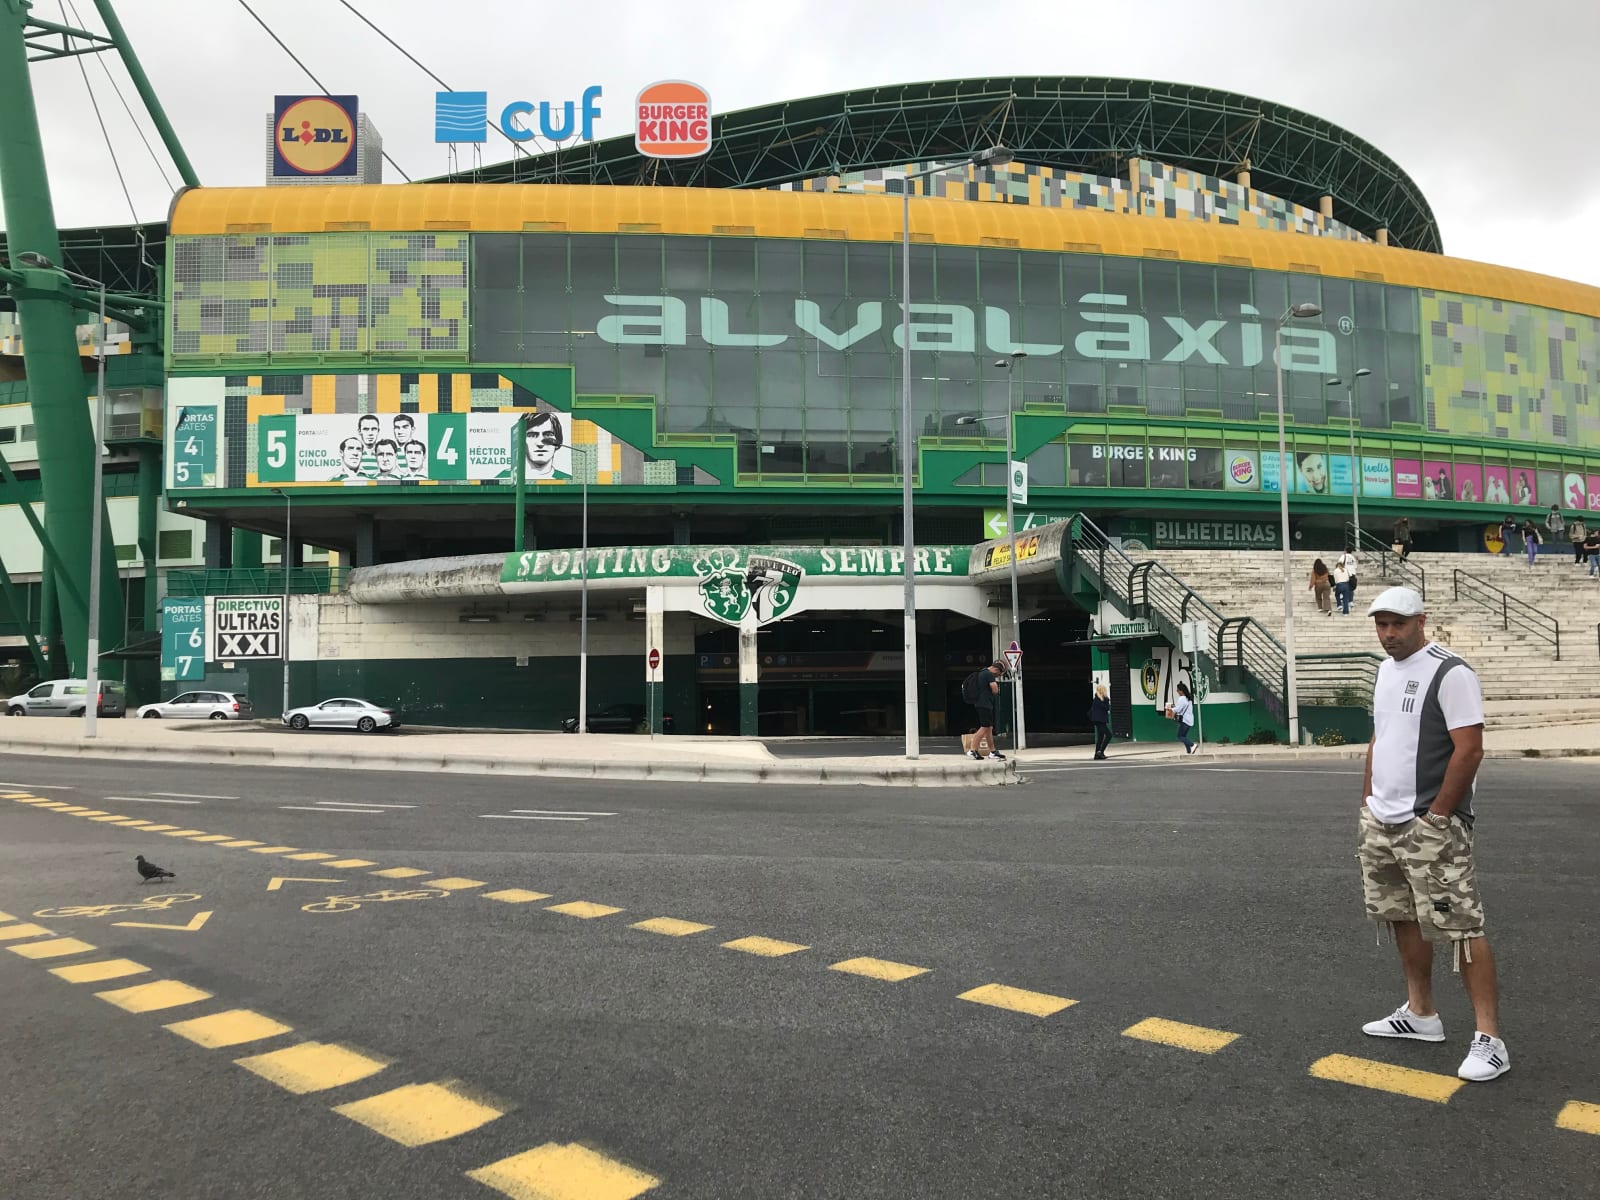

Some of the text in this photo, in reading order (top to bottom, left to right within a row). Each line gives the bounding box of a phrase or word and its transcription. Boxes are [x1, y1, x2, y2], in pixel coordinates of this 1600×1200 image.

[500, 85, 602, 142] cuf
[639, 105, 707, 120] BURGER
[639, 121, 708, 142] KING
[184, 436, 199, 455] 4
[266, 430, 287, 468] 5
[299, 450, 327, 458] CINCO
[436, 428, 458, 465] 4
[469, 445, 506, 456] HÉCTOR
[1092, 446, 1197, 462] BURGER KING
[299, 459, 342, 467] VIOLINOS
[469, 457, 512, 465] YAZALDE
[1363, 463, 1390, 473] wells
[176, 462, 189, 482] 5
[1233, 466, 1253, 478] KING
[1155, 521, 1276, 542] BILHETEIRAS
[517, 548, 671, 577] SPORTING
[820, 548, 952, 573] SEMPRE
[781, 564, 799, 577] LEO
[164, 606, 202, 614] PORTAS
[218, 600, 280, 611] DIRECTIVO
[172, 614, 202, 623] GATES
[218, 612, 280, 631] ULTRAS
[189, 628, 202, 648] 6
[221, 634, 276, 656] XXI
[179, 656, 192, 676] 7
